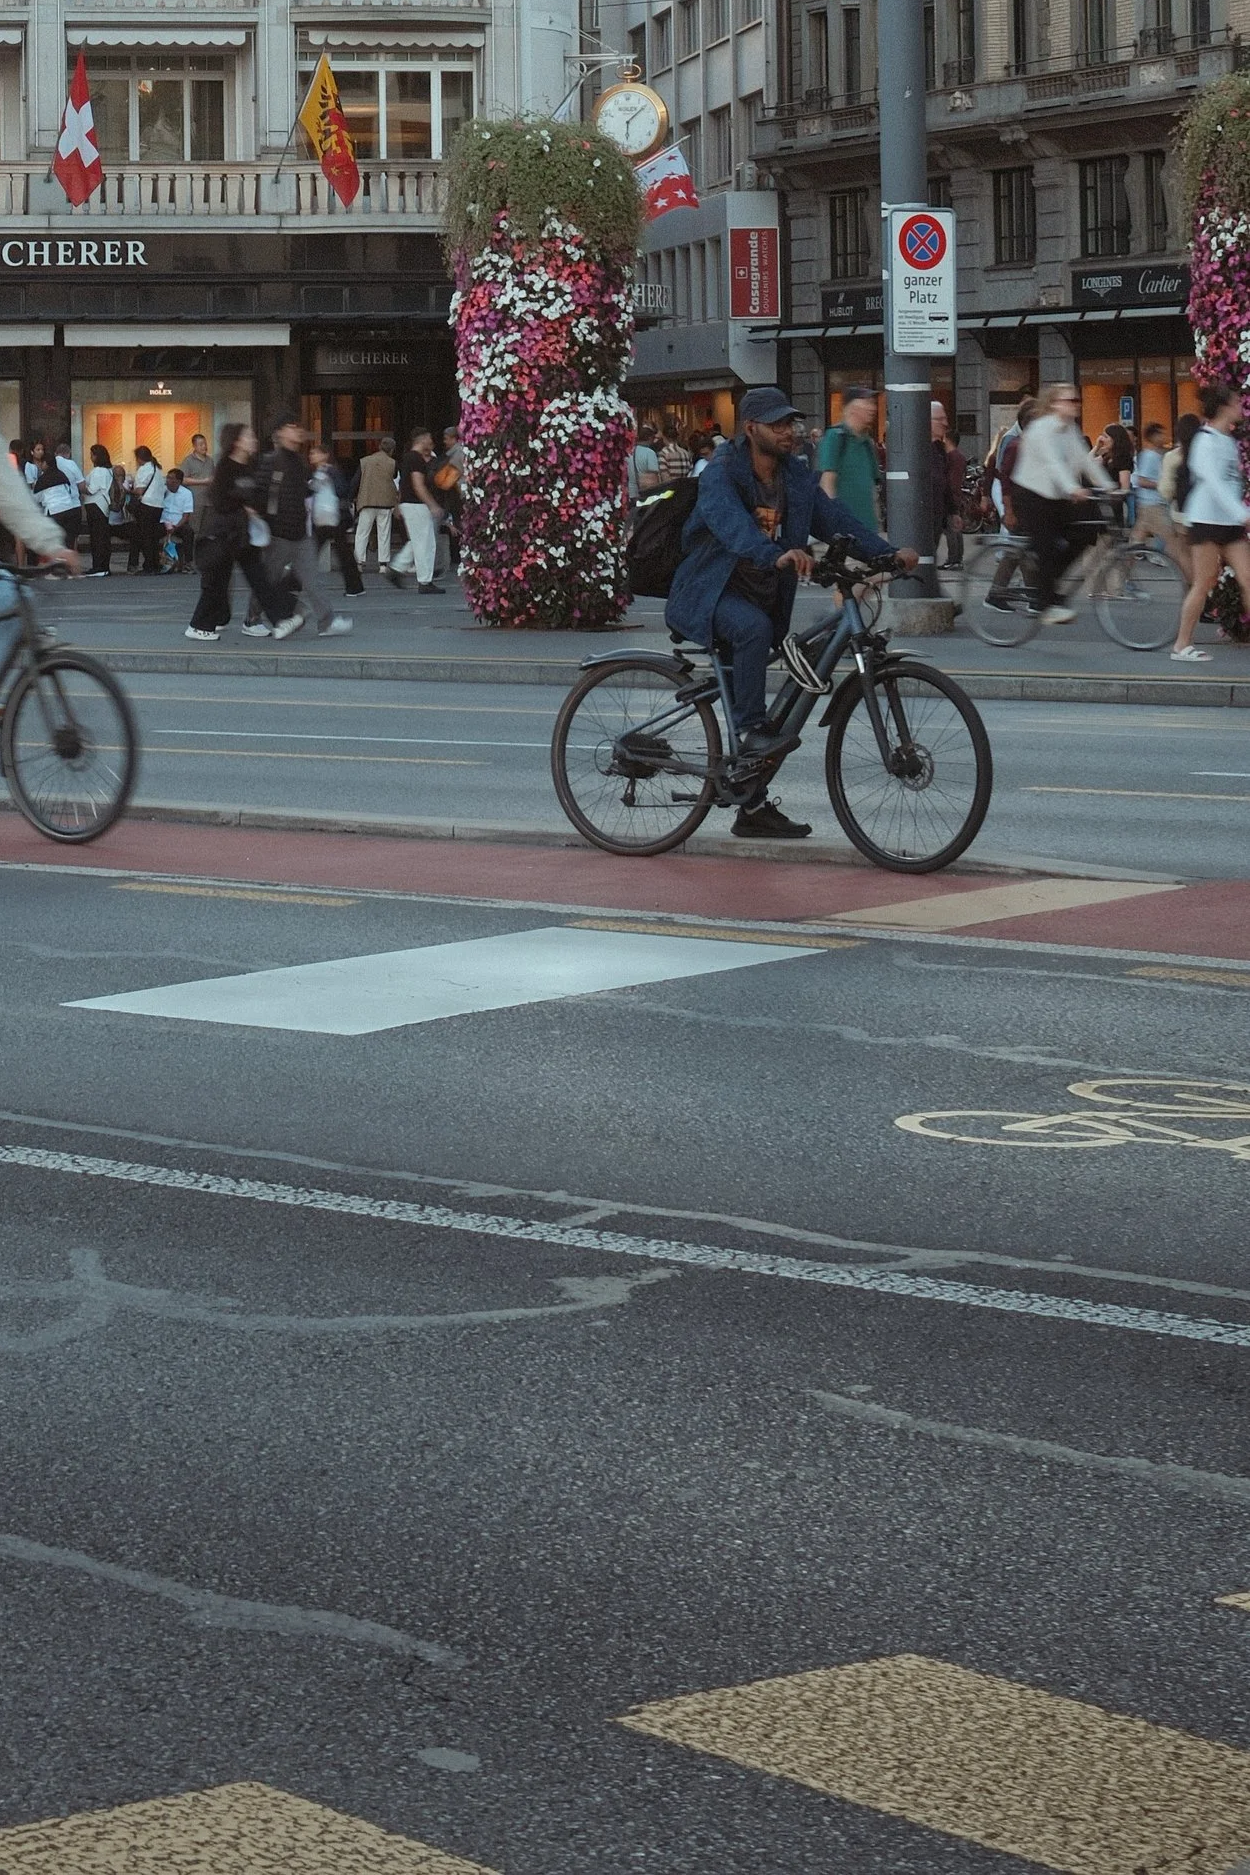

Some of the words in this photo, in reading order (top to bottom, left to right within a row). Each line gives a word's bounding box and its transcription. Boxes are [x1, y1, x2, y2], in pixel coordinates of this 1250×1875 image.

[748, 231, 761, 314] Casagrande
[904, 276, 943, 289] ganzer
[1082, 276, 1122, 289] LONGINES
[1138, 269, 1182, 294] Cartier
[910, 290, 938, 303] Platz
[829, 306, 853, 317] HUBLOT
[330, 351, 409, 365] BUCHERER
[1124, 402, 1130, 417] P
